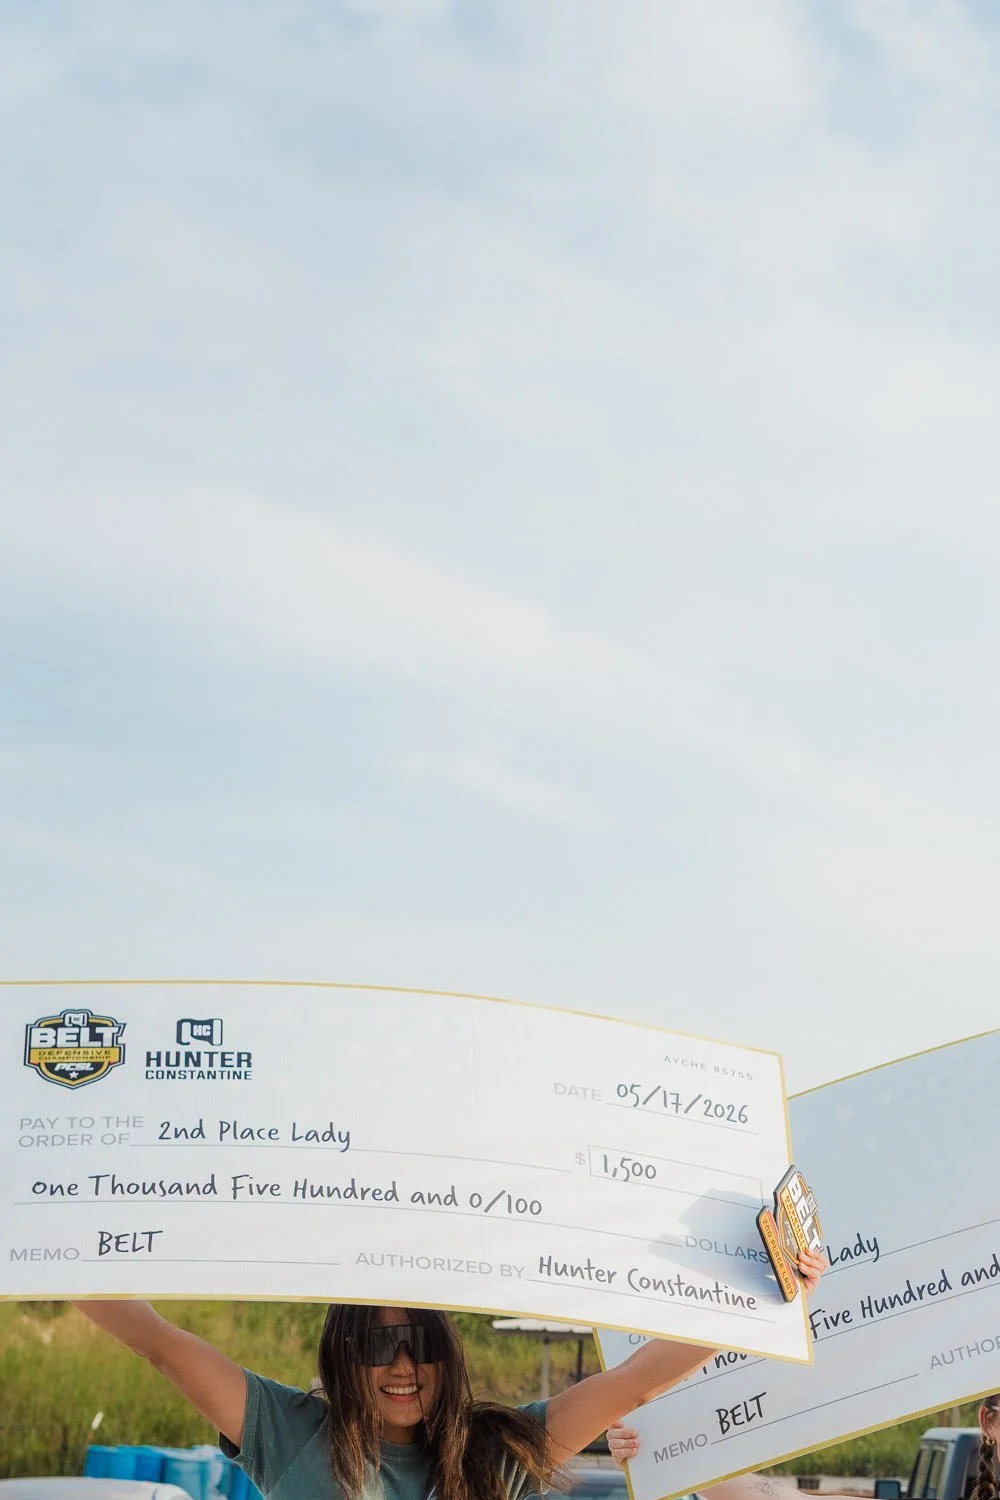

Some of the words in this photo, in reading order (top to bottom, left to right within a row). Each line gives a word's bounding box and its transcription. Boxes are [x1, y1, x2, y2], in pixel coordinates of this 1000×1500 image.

[30, 1027, 119, 1048] BELT
[193, 1025, 211, 1036] HC
[146, 1051, 252, 1068] HUNTER
[664, 1056, 706, 1070] AYCHE
[145, 1070, 252, 1081] CONSTANTINE
[553, 1082, 602, 1102] DATE
[616, 1083, 749, 1125] 05/17/2026
[19, 1134, 92, 1149] ORDER
[101, 1133, 131, 1147] OF
[158, 1119, 206, 1141] 2nd
[218, 1120, 279, 1142] Place
[292, 1122, 351, 1153] Lady
[20, 1117, 59, 1131] PAY
[67, 1116, 95, 1130] TO
[102, 1115, 144, 1129] THE
[600, 1154, 657, 1183] 1,500
[31, 1181, 79, 1197] one
[88, 1174, 218, 1197] Thousand
[231, 1175, 282, 1200] Five
[293, 1178, 399, 1203] Hundred
[410, 1186, 458, 1208] and
[469, 1189, 542, 1216] 0/100
[10, 1248, 80, 1262] MEMO
[97, 1230, 163, 1256] BELT
[685, 1234, 770, 1264] DOLLARS
[827, 1233, 879, 1266] Lady
[355, 1252, 493, 1275] AUTHORIZED
[499, 1265, 526, 1279] BY
[538, 1256, 617, 1285] Hunter
[627, 1268, 758, 1311] Constantine
[809, 1308, 853, 1339] Five
[861, 1269, 952, 1318] Hundred
[654, 1434, 708, 1464] MEMO
[716, 1392, 767, 1434] BELT
